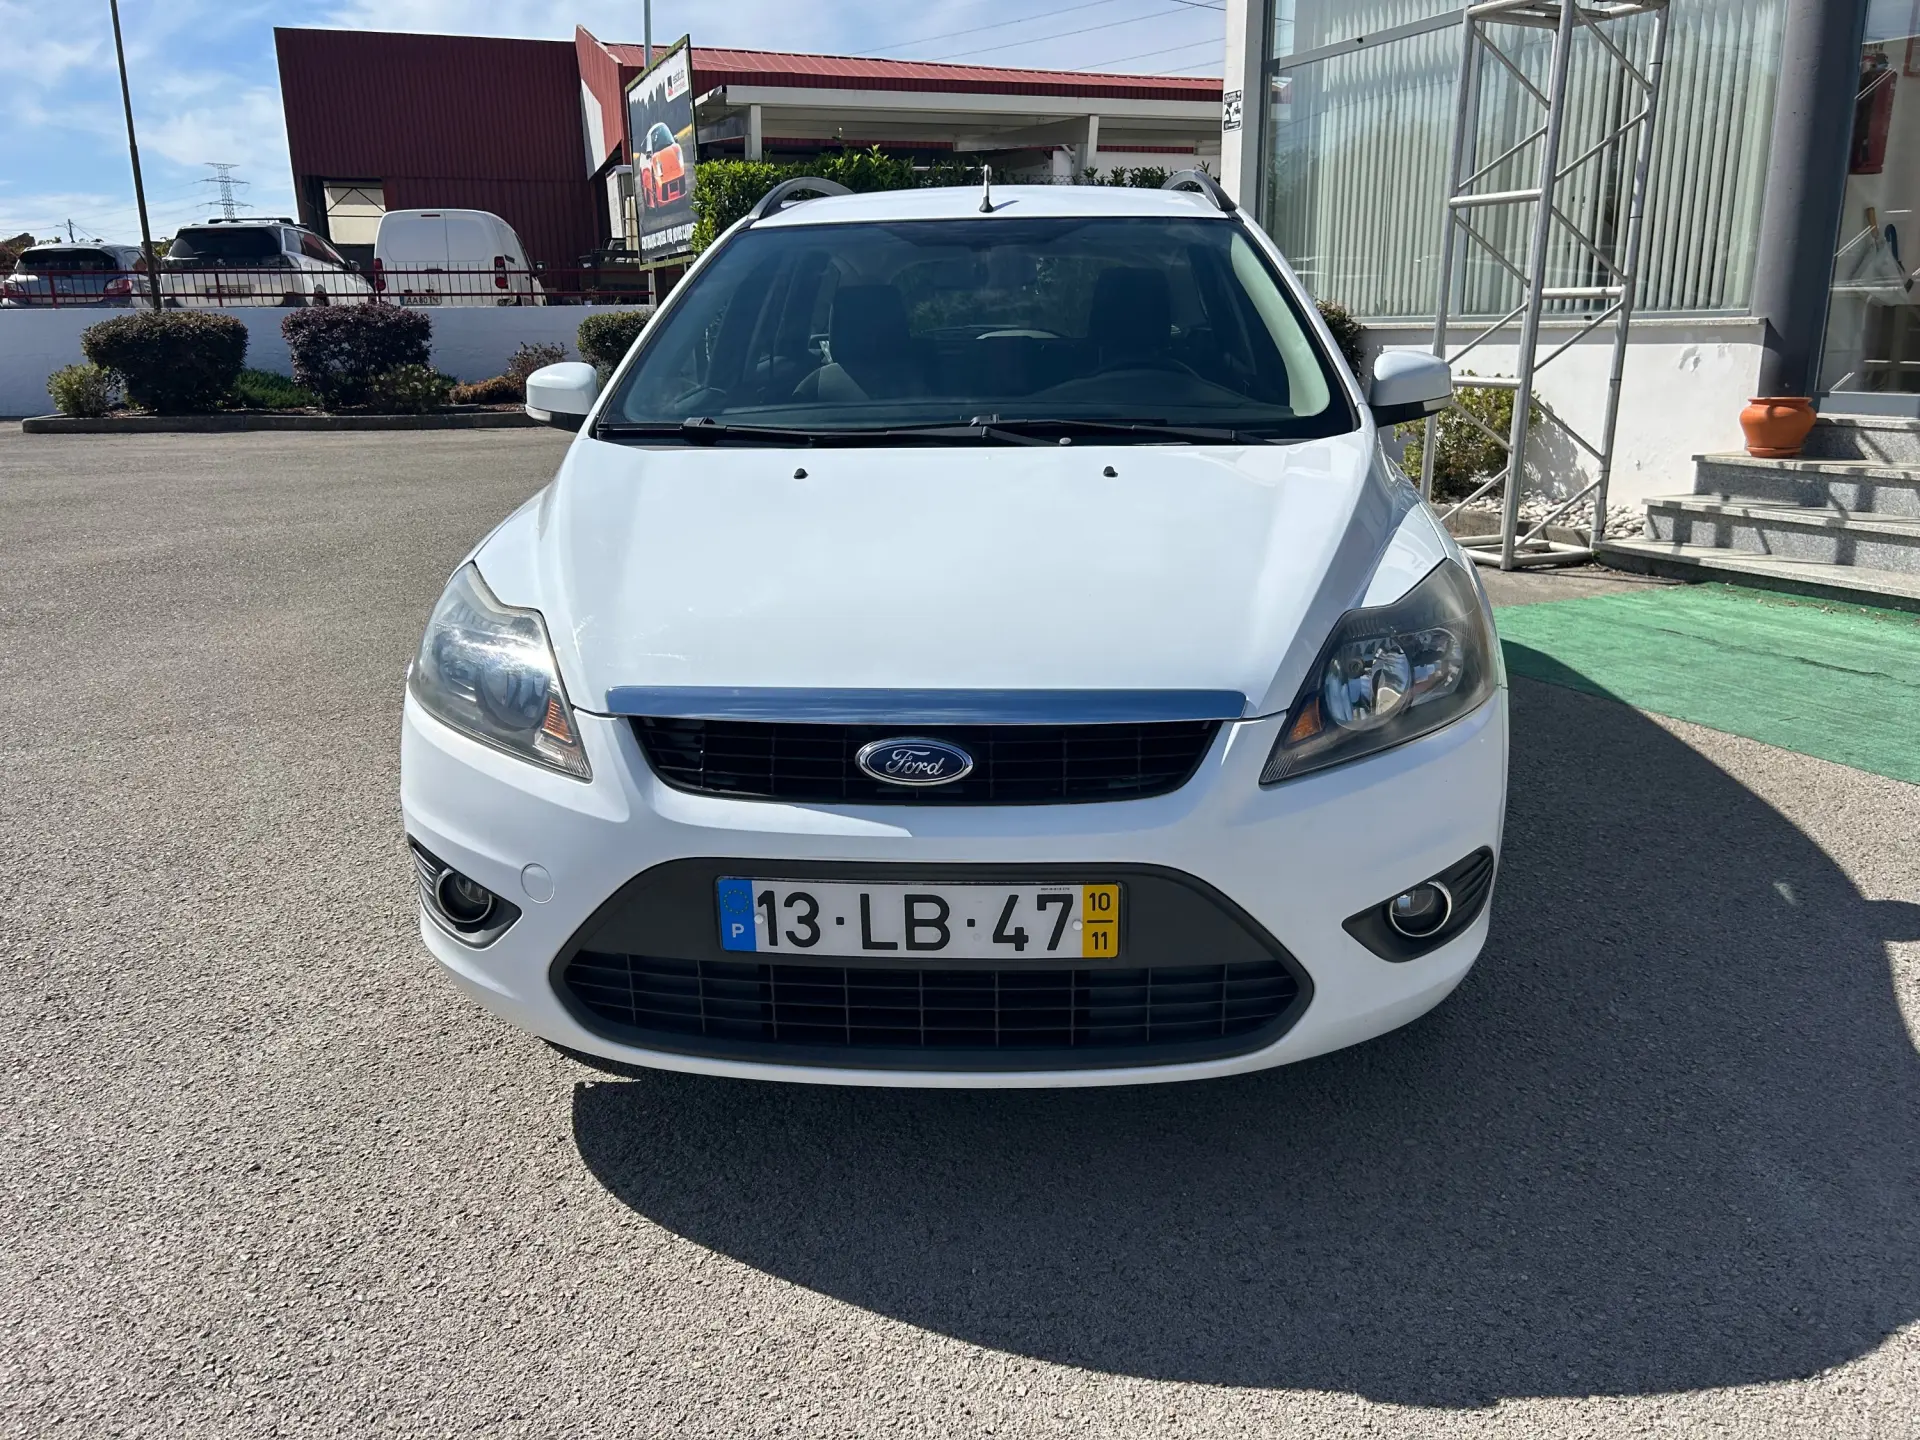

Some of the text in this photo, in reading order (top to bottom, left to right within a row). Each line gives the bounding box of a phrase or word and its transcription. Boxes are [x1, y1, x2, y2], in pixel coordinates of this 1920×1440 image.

[885, 749, 945, 775] Ford
[1089, 892, 1111, 912] 10
[731, 923, 745, 938] P
[1092, 931, 1108, 951] 11
